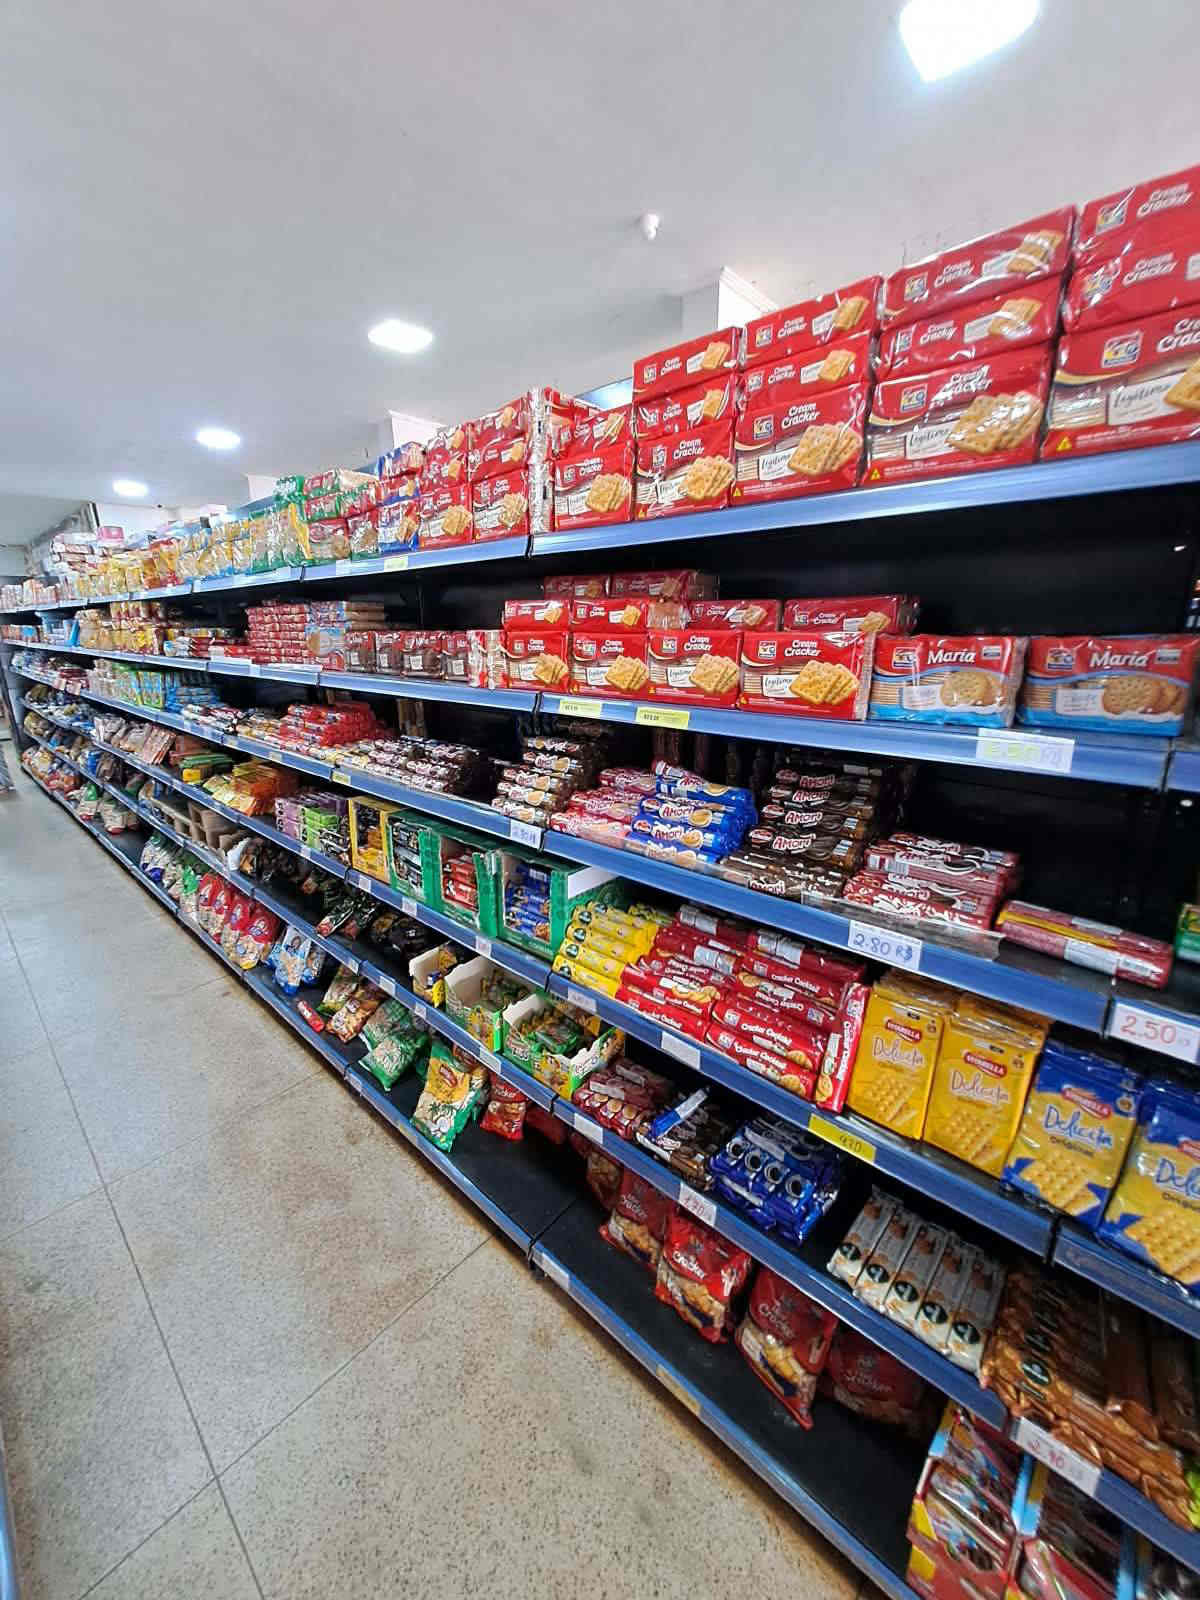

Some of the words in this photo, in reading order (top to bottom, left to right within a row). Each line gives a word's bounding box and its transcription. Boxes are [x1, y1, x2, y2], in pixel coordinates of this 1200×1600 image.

[788, 403, 817, 417] Cream
[781, 411, 821, 430] Cracker
[679, 438, 702, 450] Cream
[673, 446, 705, 460] Cracker
[683, 642, 713, 651] Cracker
[791, 639, 819, 648] Cream
[783, 647, 822, 657] Cracker
[853, 932, 891, 955] 2.80
[1120, 1014, 1177, 1045] 2.50
